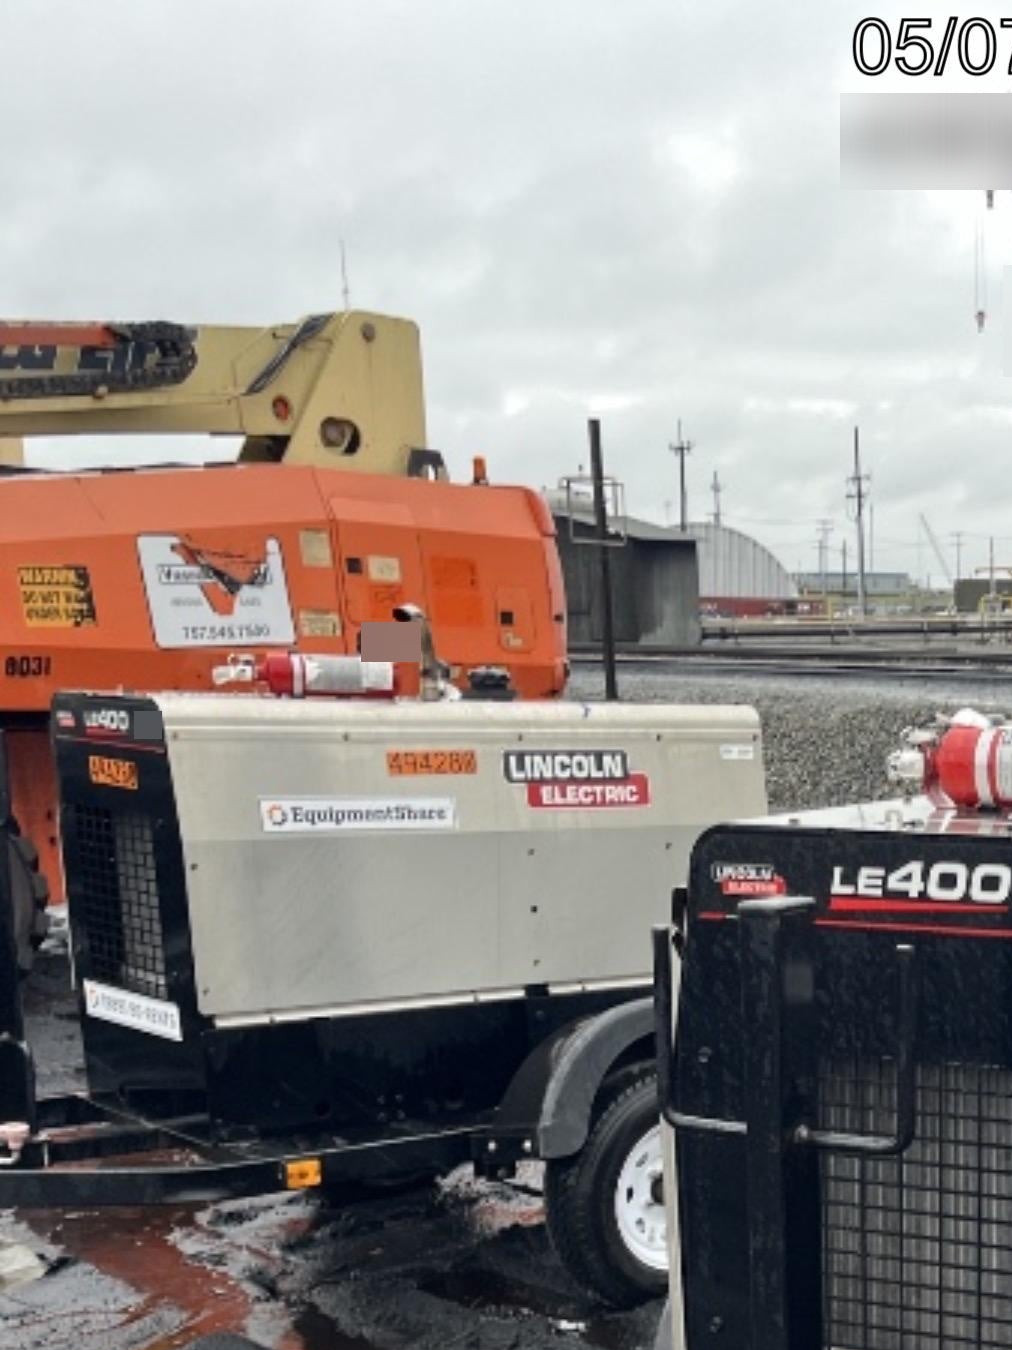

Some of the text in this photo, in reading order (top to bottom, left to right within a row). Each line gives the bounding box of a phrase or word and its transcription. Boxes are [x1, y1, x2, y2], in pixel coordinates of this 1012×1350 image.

[508, 755, 624, 779] LINCOLN
[540, 785, 639, 803] ELECTRIC
[292, 807, 447, 825] EquipmentShare
[830, 861, 1012, 903] LE400
